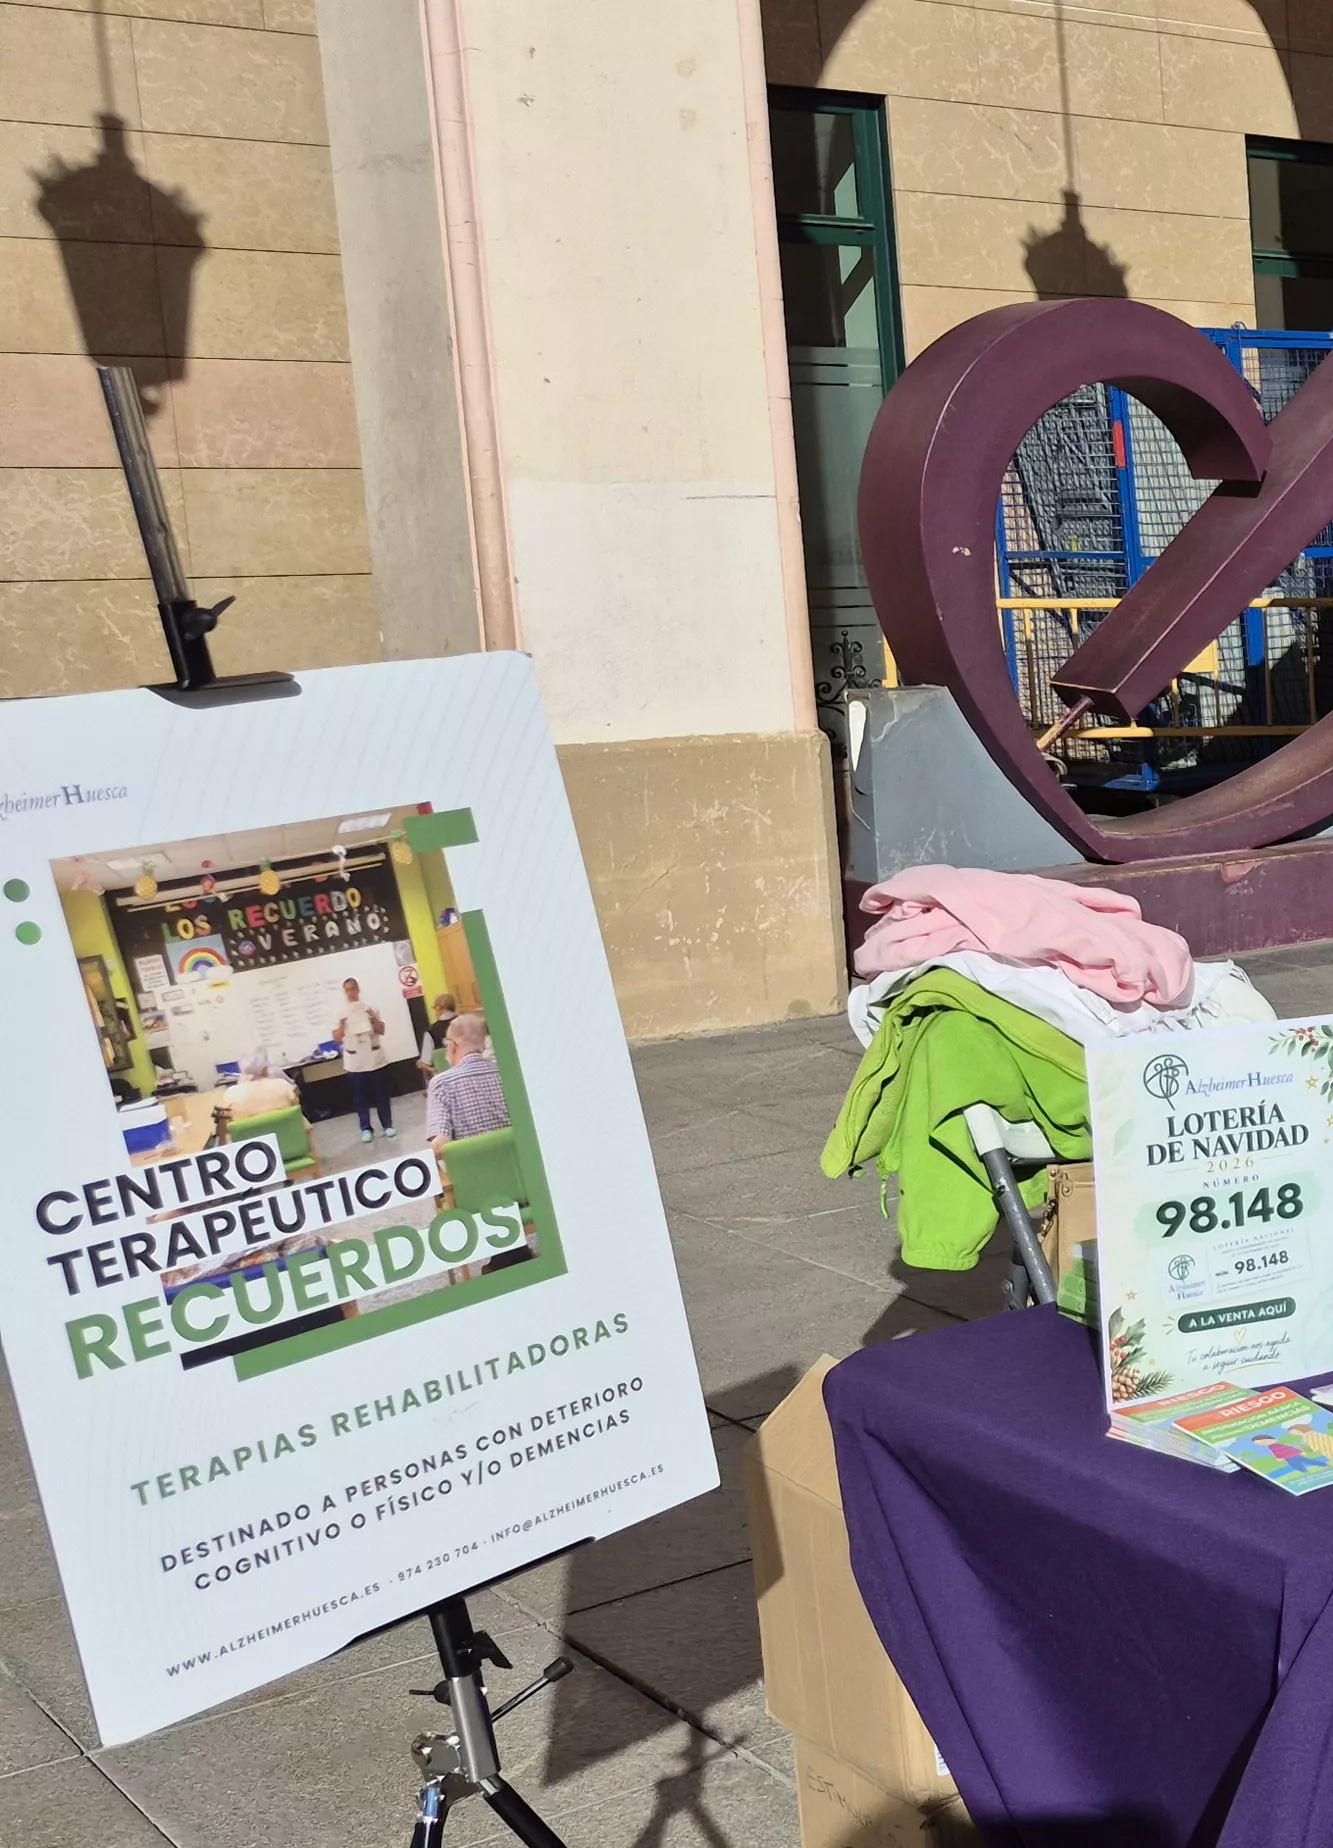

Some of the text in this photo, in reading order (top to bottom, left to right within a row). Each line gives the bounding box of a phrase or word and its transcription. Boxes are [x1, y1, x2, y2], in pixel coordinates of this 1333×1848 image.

[162, 914, 212, 943] LOS
[257, 912, 381, 950] VERANO
[1167, 1099, 1285, 1138] LOTERÍA
[1146, 1124, 1309, 1166] DE NAVIDAD
[1207, 1157, 1254, 1174] 2026
[35, 1140, 277, 1236] CENTRO
[1203, 1174, 1260, 1189] NÚMERO
[47, 1157, 432, 1296] TERAPÉUTICO
[1156, 1182, 1303, 1238] 98.148
[1234, 1250, 1289, 1275] 98.148
[64, 1195, 523, 1380] RECUERDOS
[1188, 1301, 1287, 1329] A LA VENTA AQUÍ
[130, 1312, 630, 1507] TERAPIAS REHABILITADORAS
[1219, 1391, 1287, 1417] RIESGO
[160, 1376, 645, 1573] DESTINADO A PERSONAS CON DETERIORO
[194, 1410, 631, 1590] COGNITIVO O FÍSICO Y/O DEMENCIAS
[166, 1464, 665, 1677] WWW.ALZHEIMERHUESCA.ES 974 230 704 INFO@ALZHEIMERHUESCA.ES
